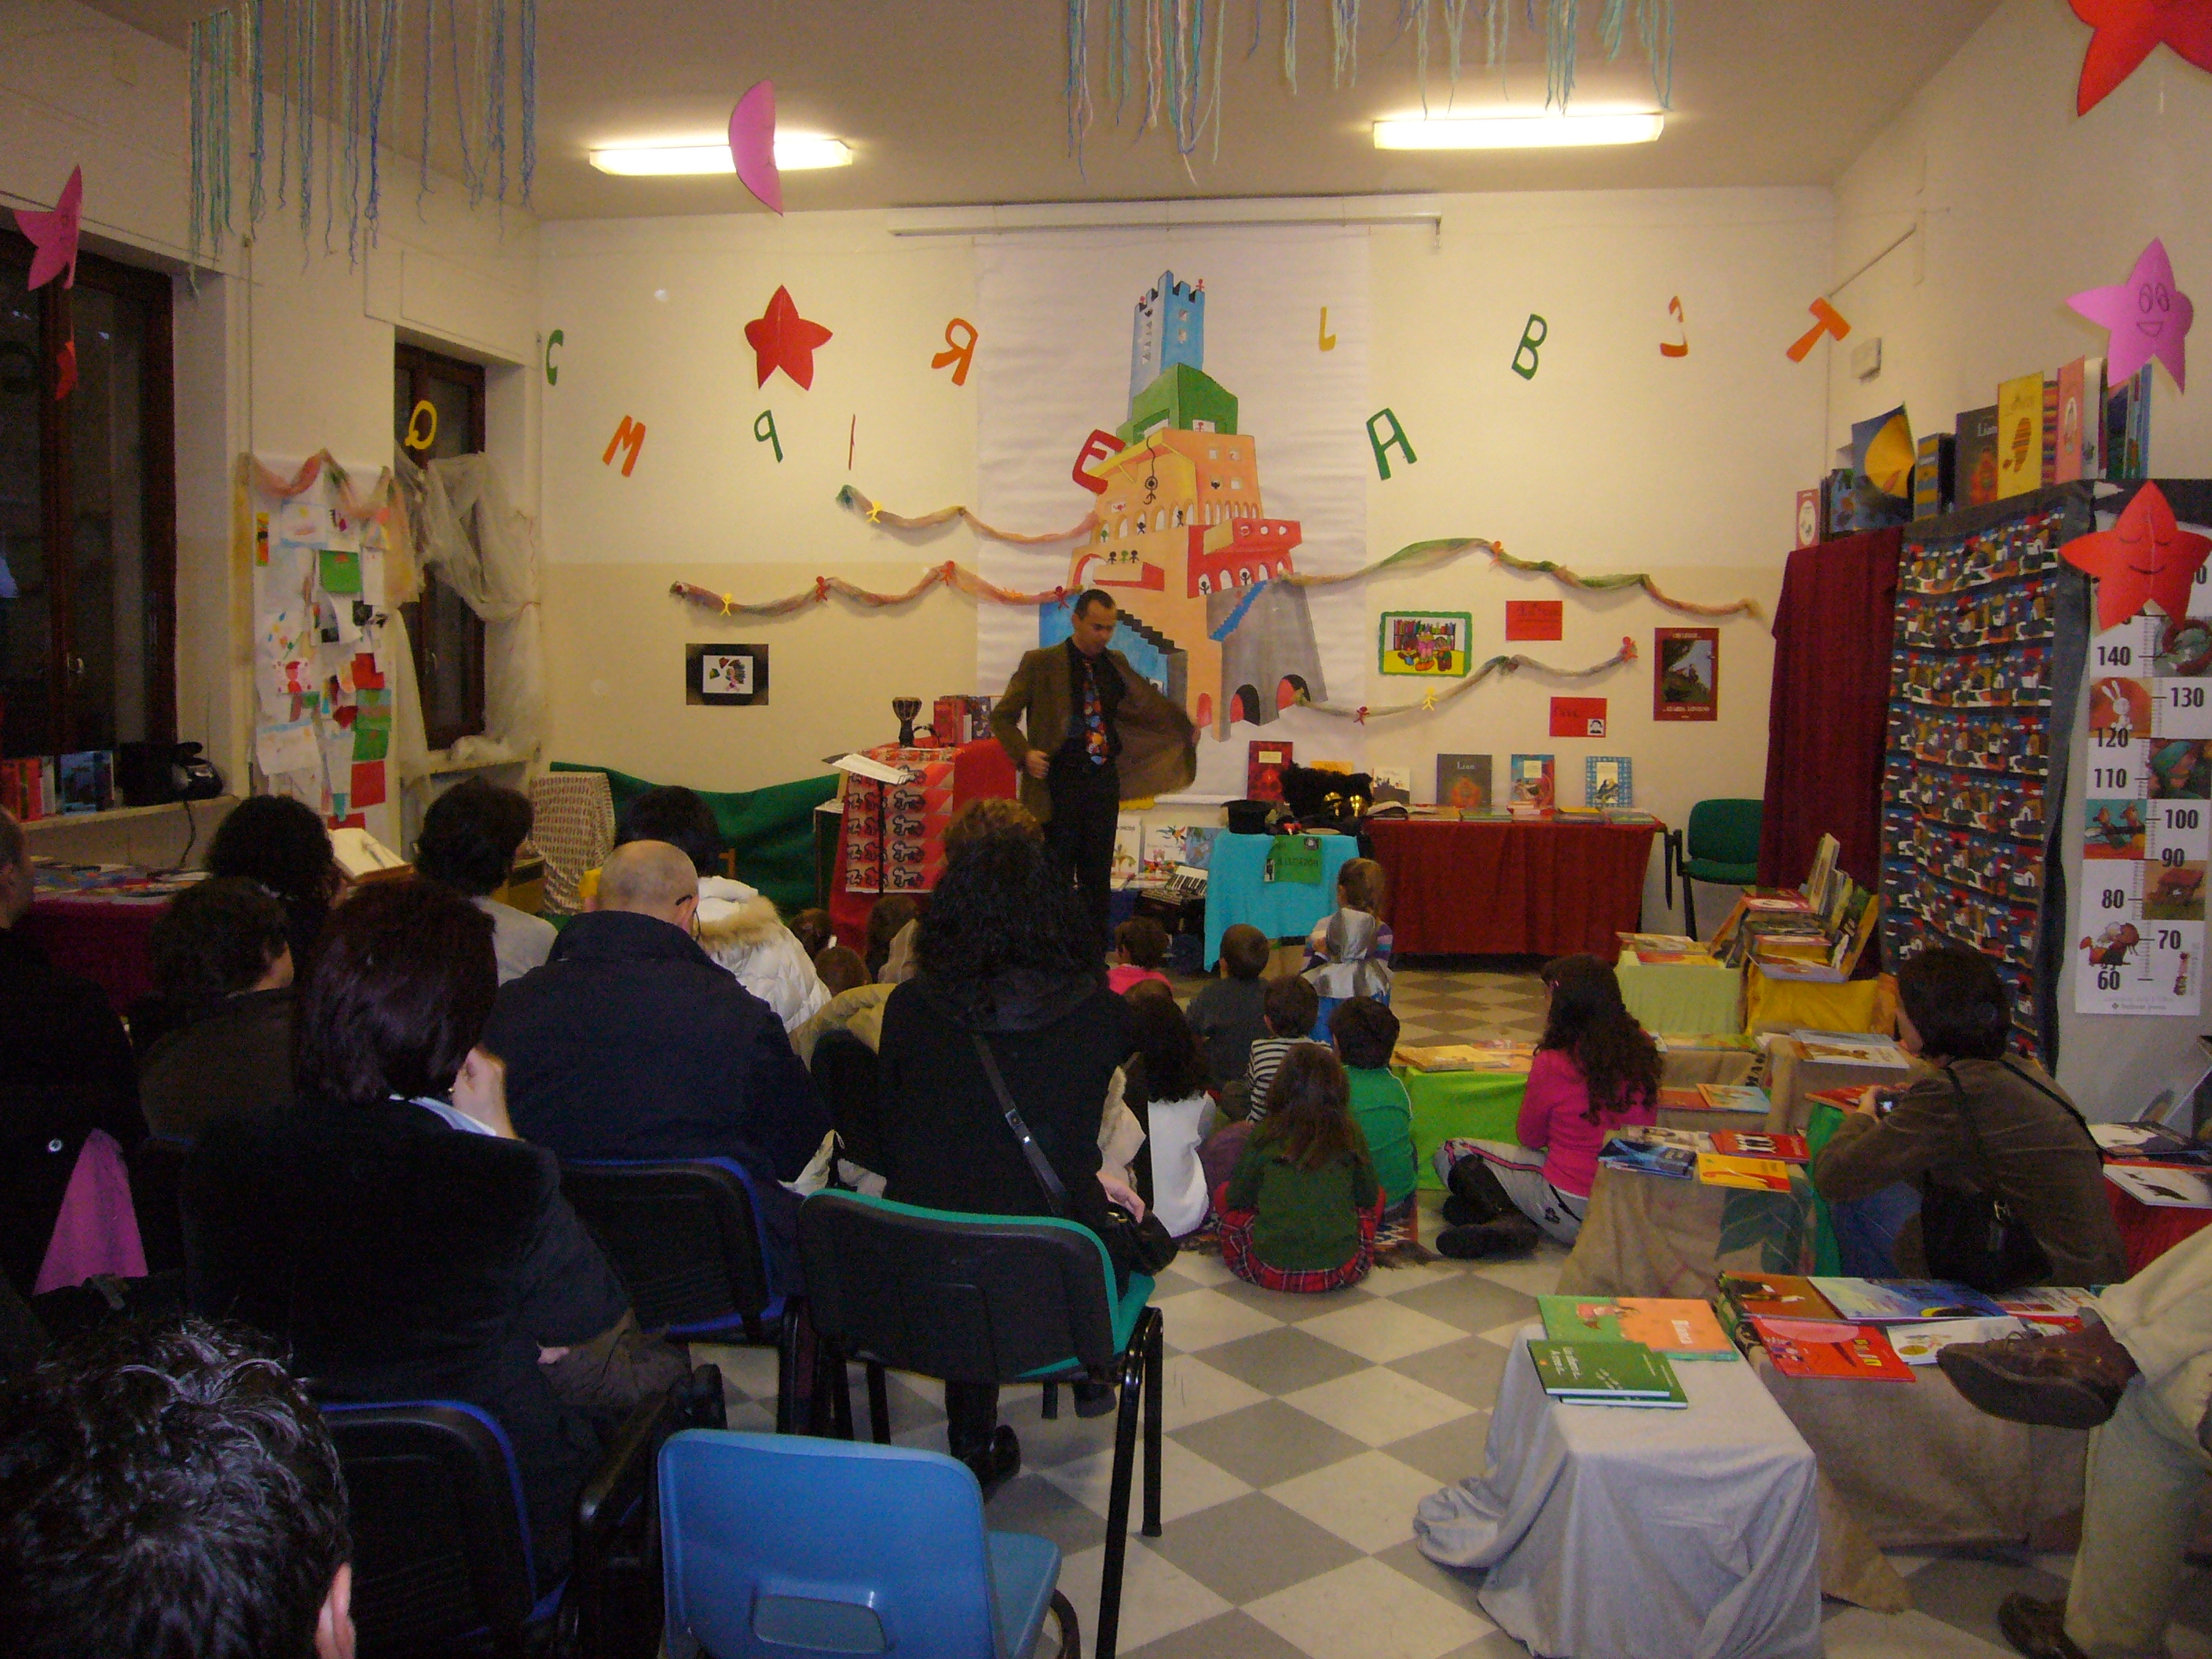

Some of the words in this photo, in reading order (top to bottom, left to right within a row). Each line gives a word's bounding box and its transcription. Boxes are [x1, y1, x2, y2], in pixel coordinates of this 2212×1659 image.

[1785, 297, 1852, 363] T
[1511, 313, 1547, 380] B
[602, 415, 646, 477] M
[1366, 408, 1417, 481] A
[1072, 429, 1126, 495] E
[2097, 646, 2130, 666] 140
[2171, 687, 2204, 708] 130
[2097, 727, 2129, 748] 120
[2094, 768, 2126, 789] 110
[2165, 809, 2199, 830] 100
[2162, 848, 2185, 867] 90
[2101, 889, 2124, 909] 80
[2158, 929, 2181, 950] 70
[2097, 970, 2120, 991] 60
